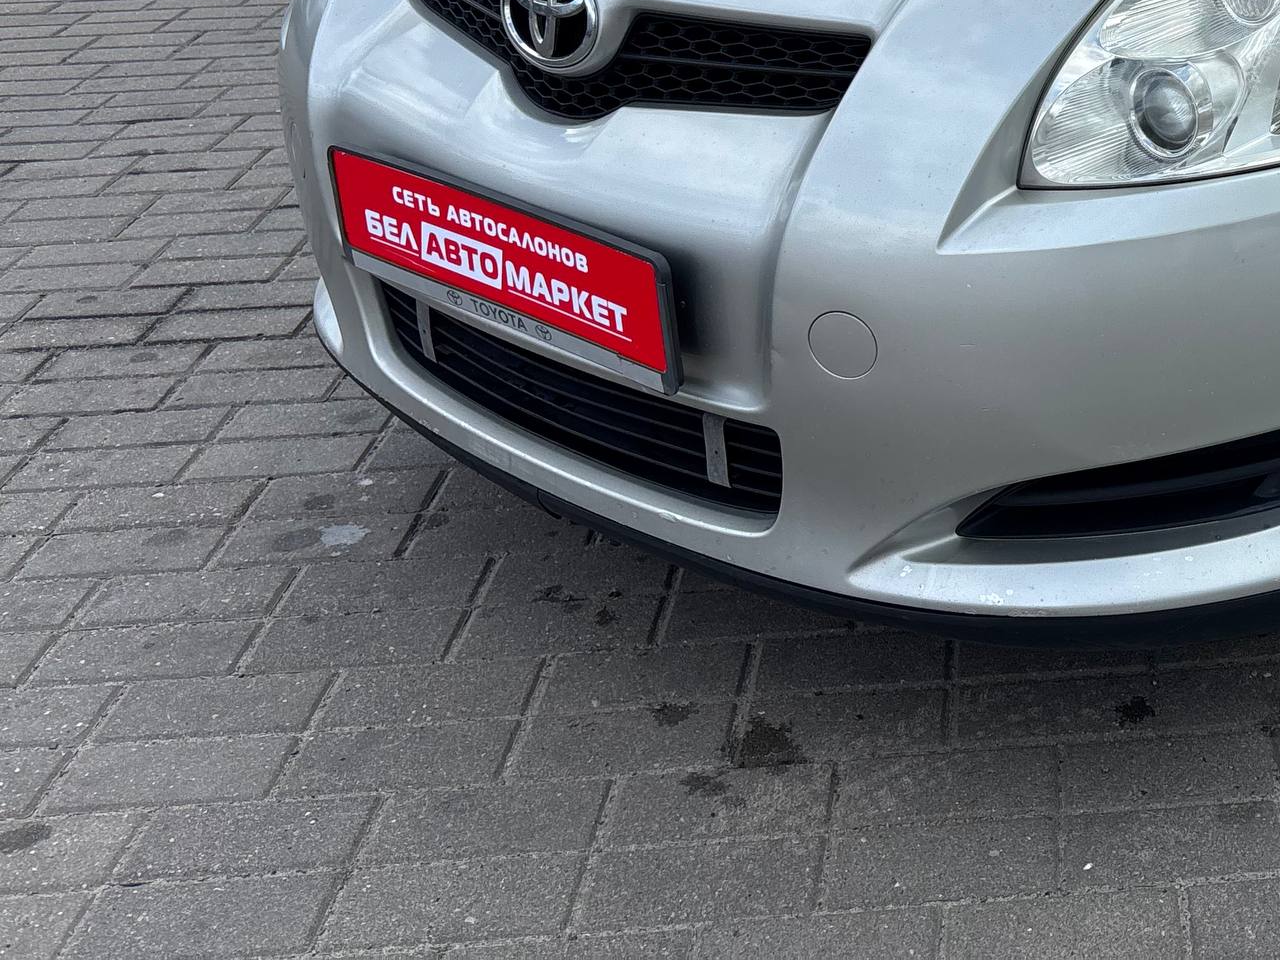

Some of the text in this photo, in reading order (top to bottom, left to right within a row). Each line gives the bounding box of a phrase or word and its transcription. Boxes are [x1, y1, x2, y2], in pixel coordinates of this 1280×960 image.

[392, 186, 589, 273] СЕТЬ АВТОСАЛОНОВ
[470, 298, 528, 332] TOYOTA
